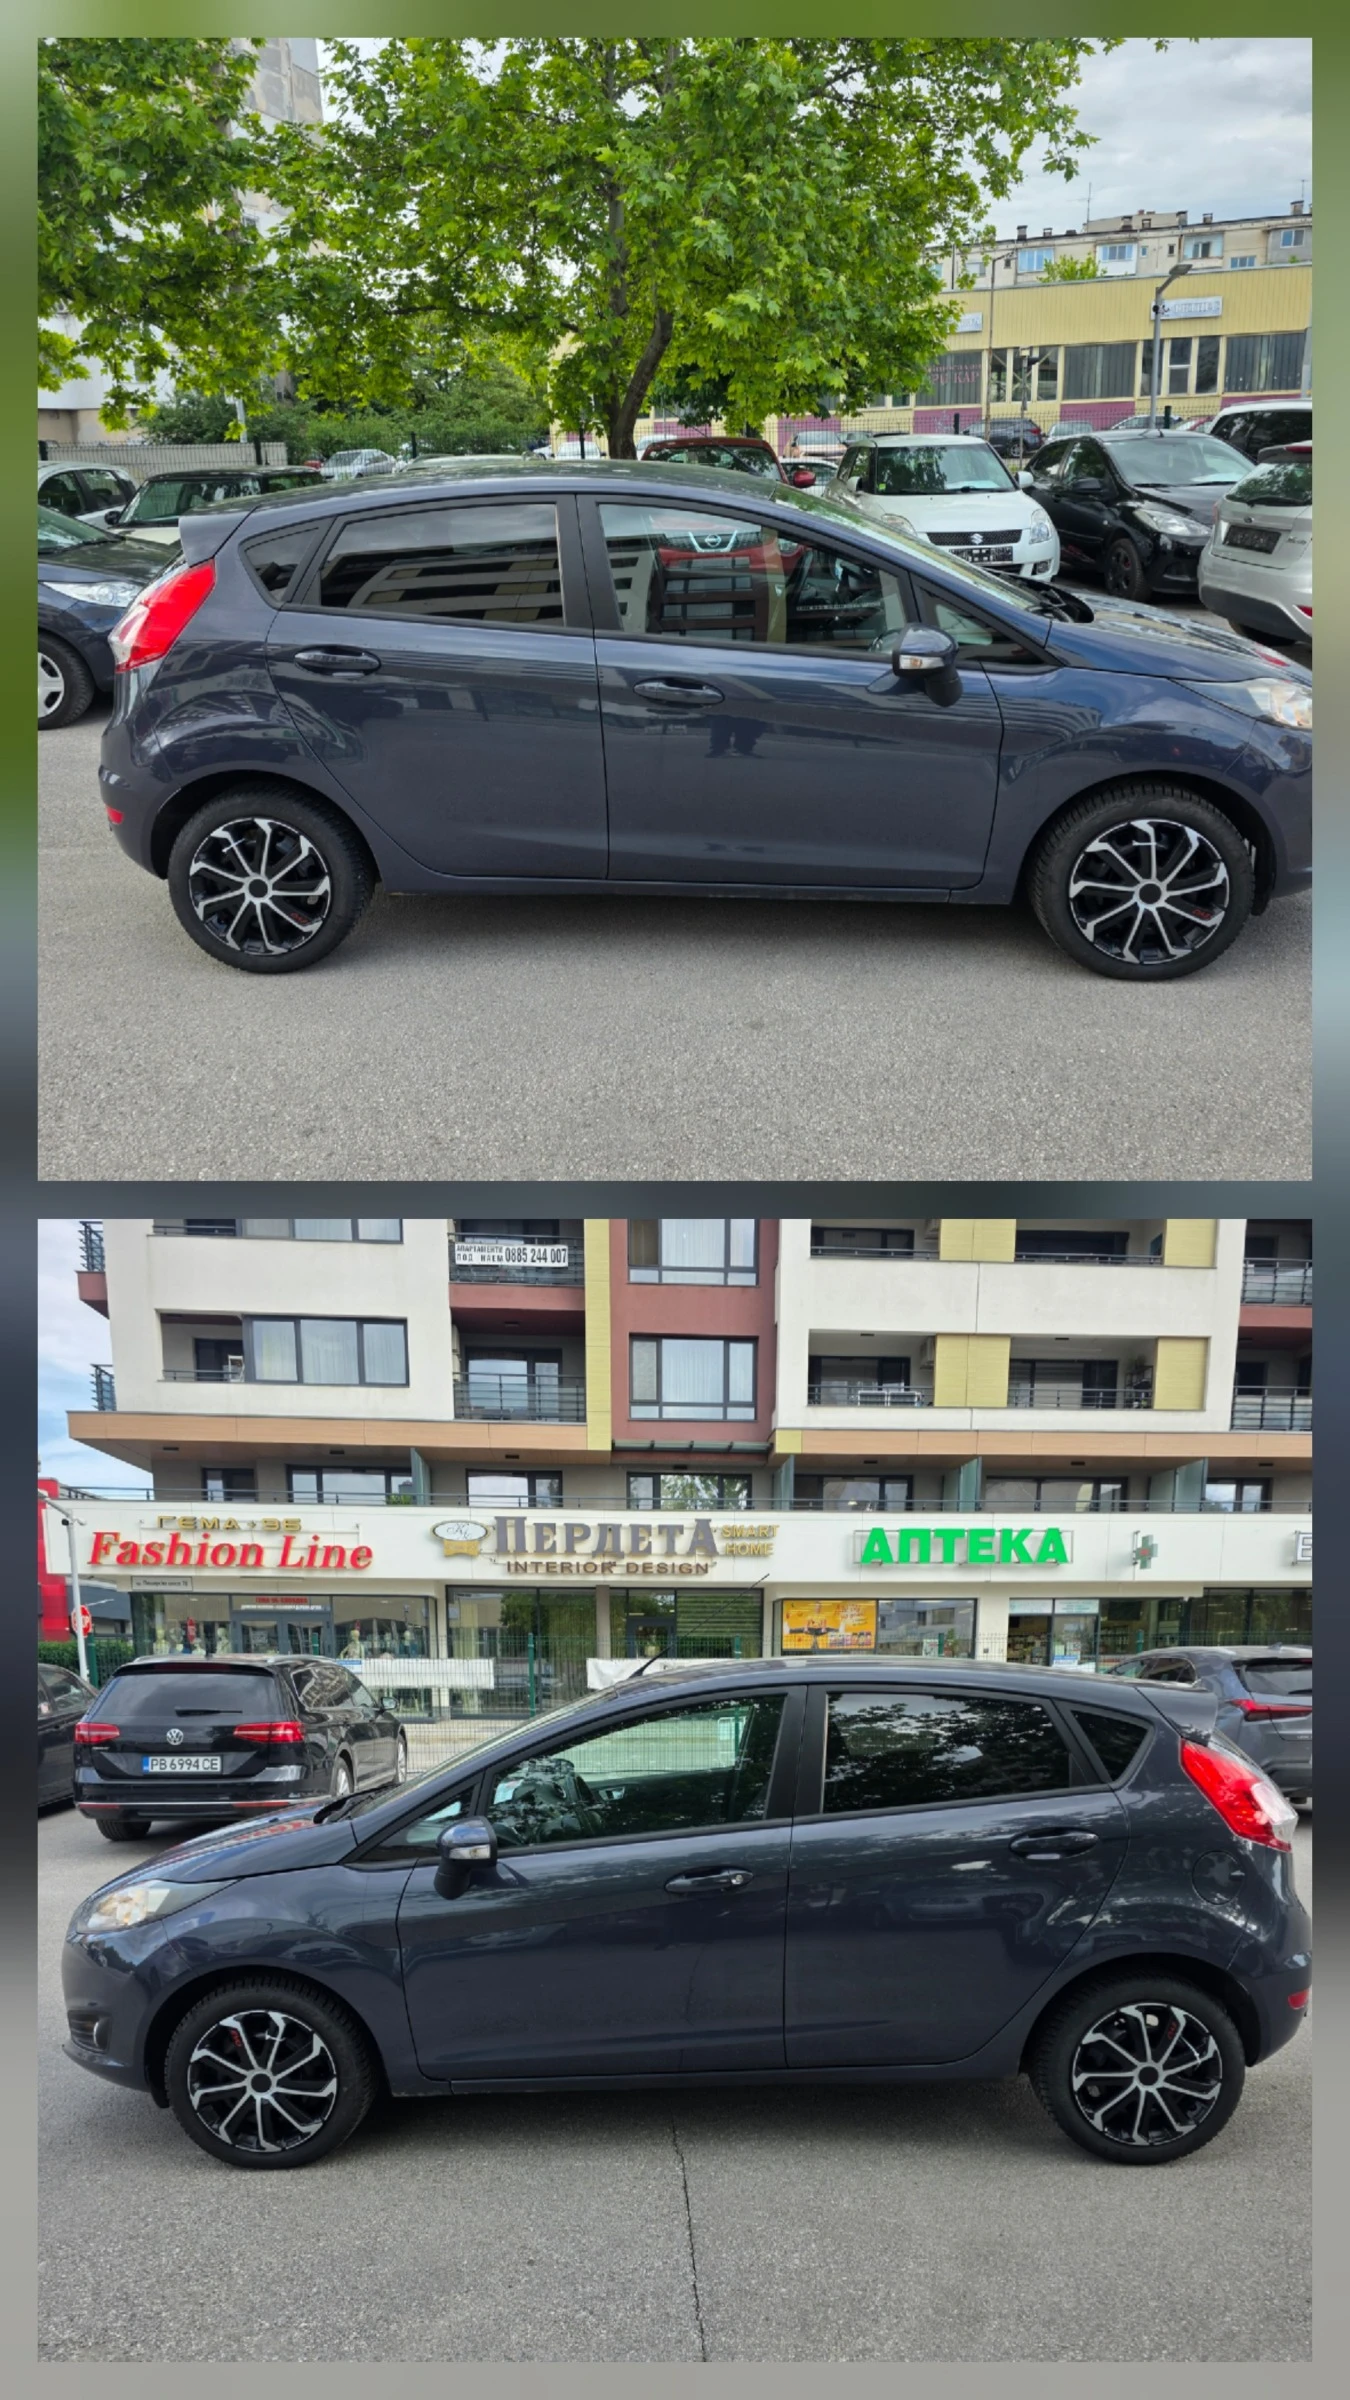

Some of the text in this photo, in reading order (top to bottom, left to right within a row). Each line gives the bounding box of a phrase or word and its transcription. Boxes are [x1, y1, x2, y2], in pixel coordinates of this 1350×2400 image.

[457, 1253, 504, 1263] ПОД НАЕМ
[505, 1247, 567, 1263] 0885 244 007
[157, 1515, 240, 1531] ГЕМА
[494, 1515, 720, 1560] ПЕРДЕТА
[721, 1524, 780, 1539] SMART
[88, 1531, 374, 1570] Fashion Line
[725, 1542, 774, 1556] HOME
[860, 1527, 1070, 1565] АПТЕКА
[506, 1560, 710, 1575] INTERIOR DESIGN
[150, 1757, 219, 1771] PB 6994 CE
